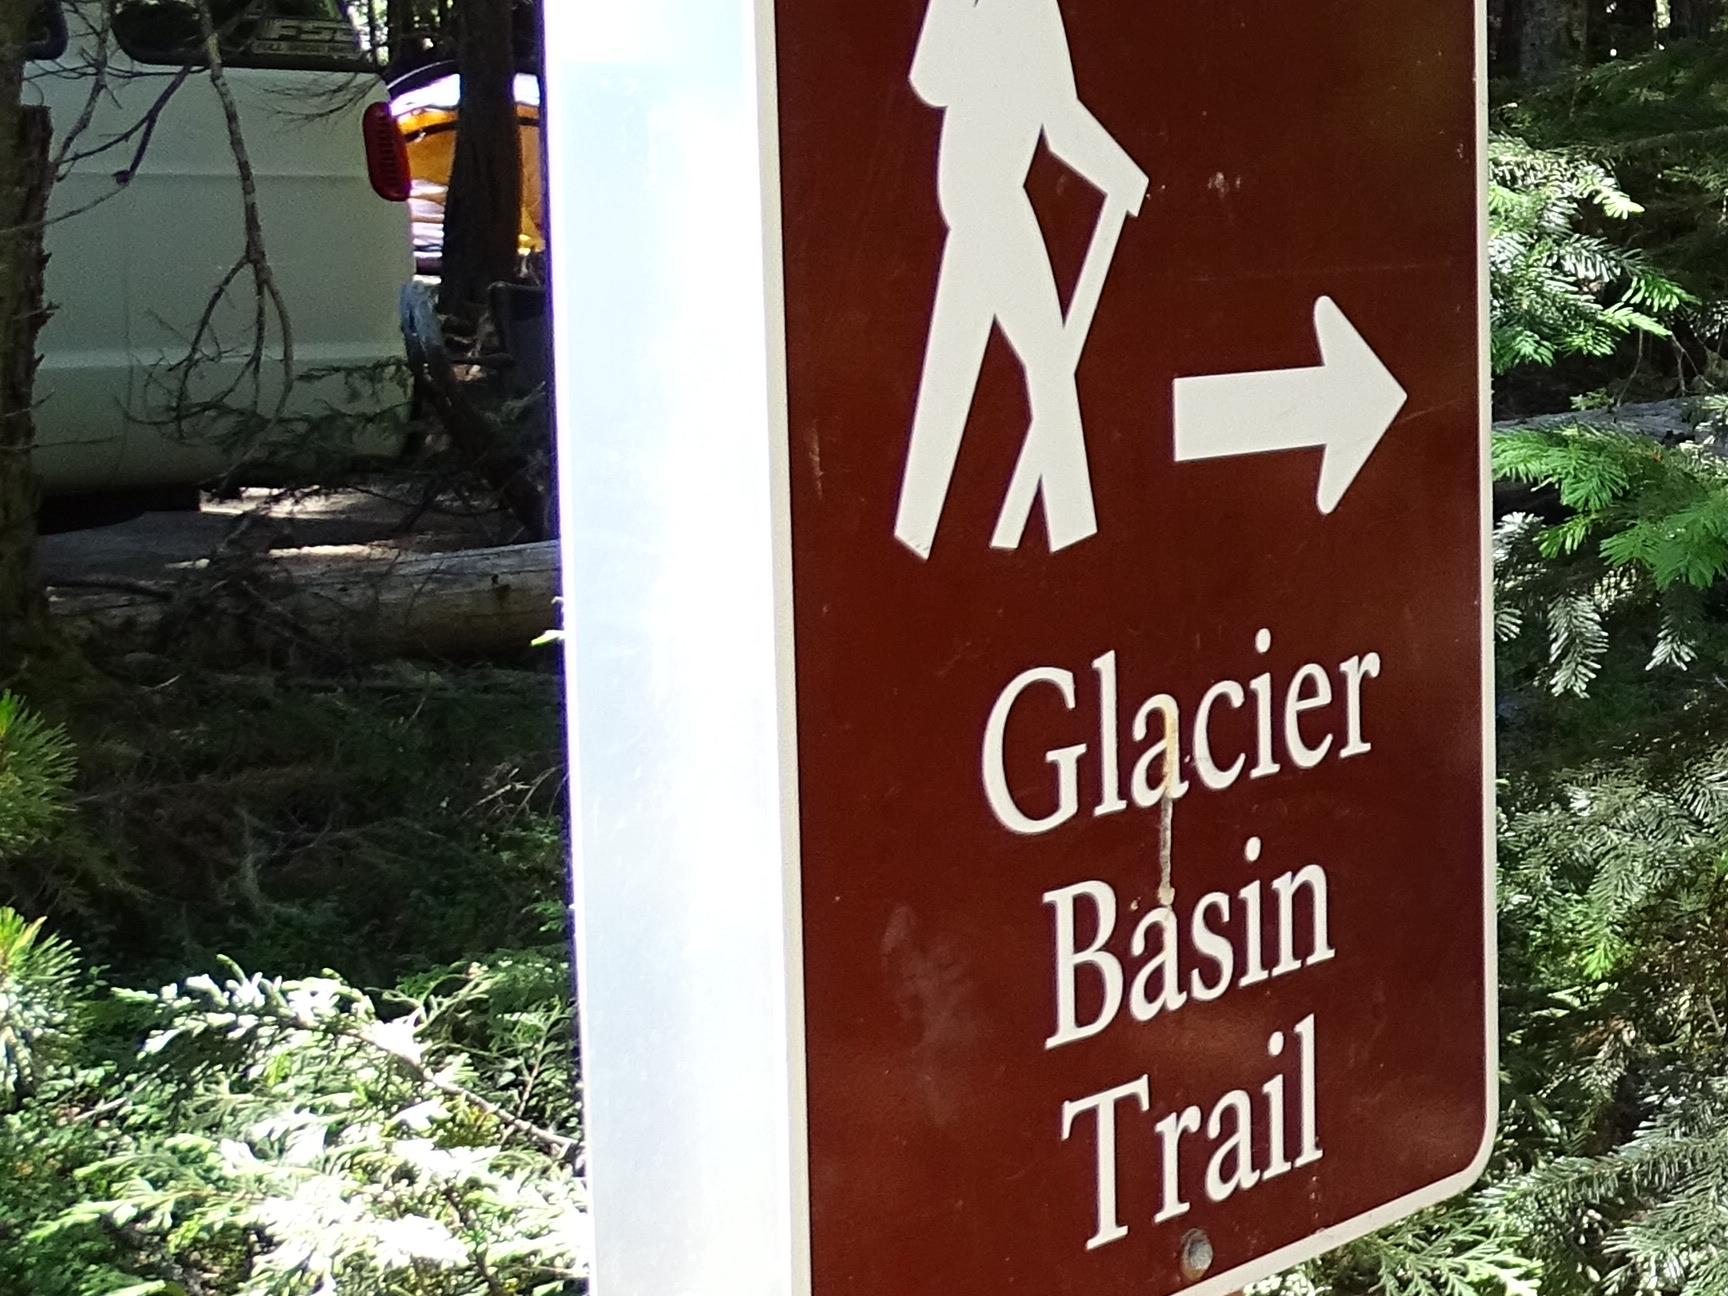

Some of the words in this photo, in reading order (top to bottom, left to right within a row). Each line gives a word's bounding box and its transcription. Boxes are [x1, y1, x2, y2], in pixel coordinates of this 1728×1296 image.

[981, 627, 1380, 835] Glacier
[1041, 836, 1336, 1049] Basin
[1060, 1013, 1323, 1250] Trail
